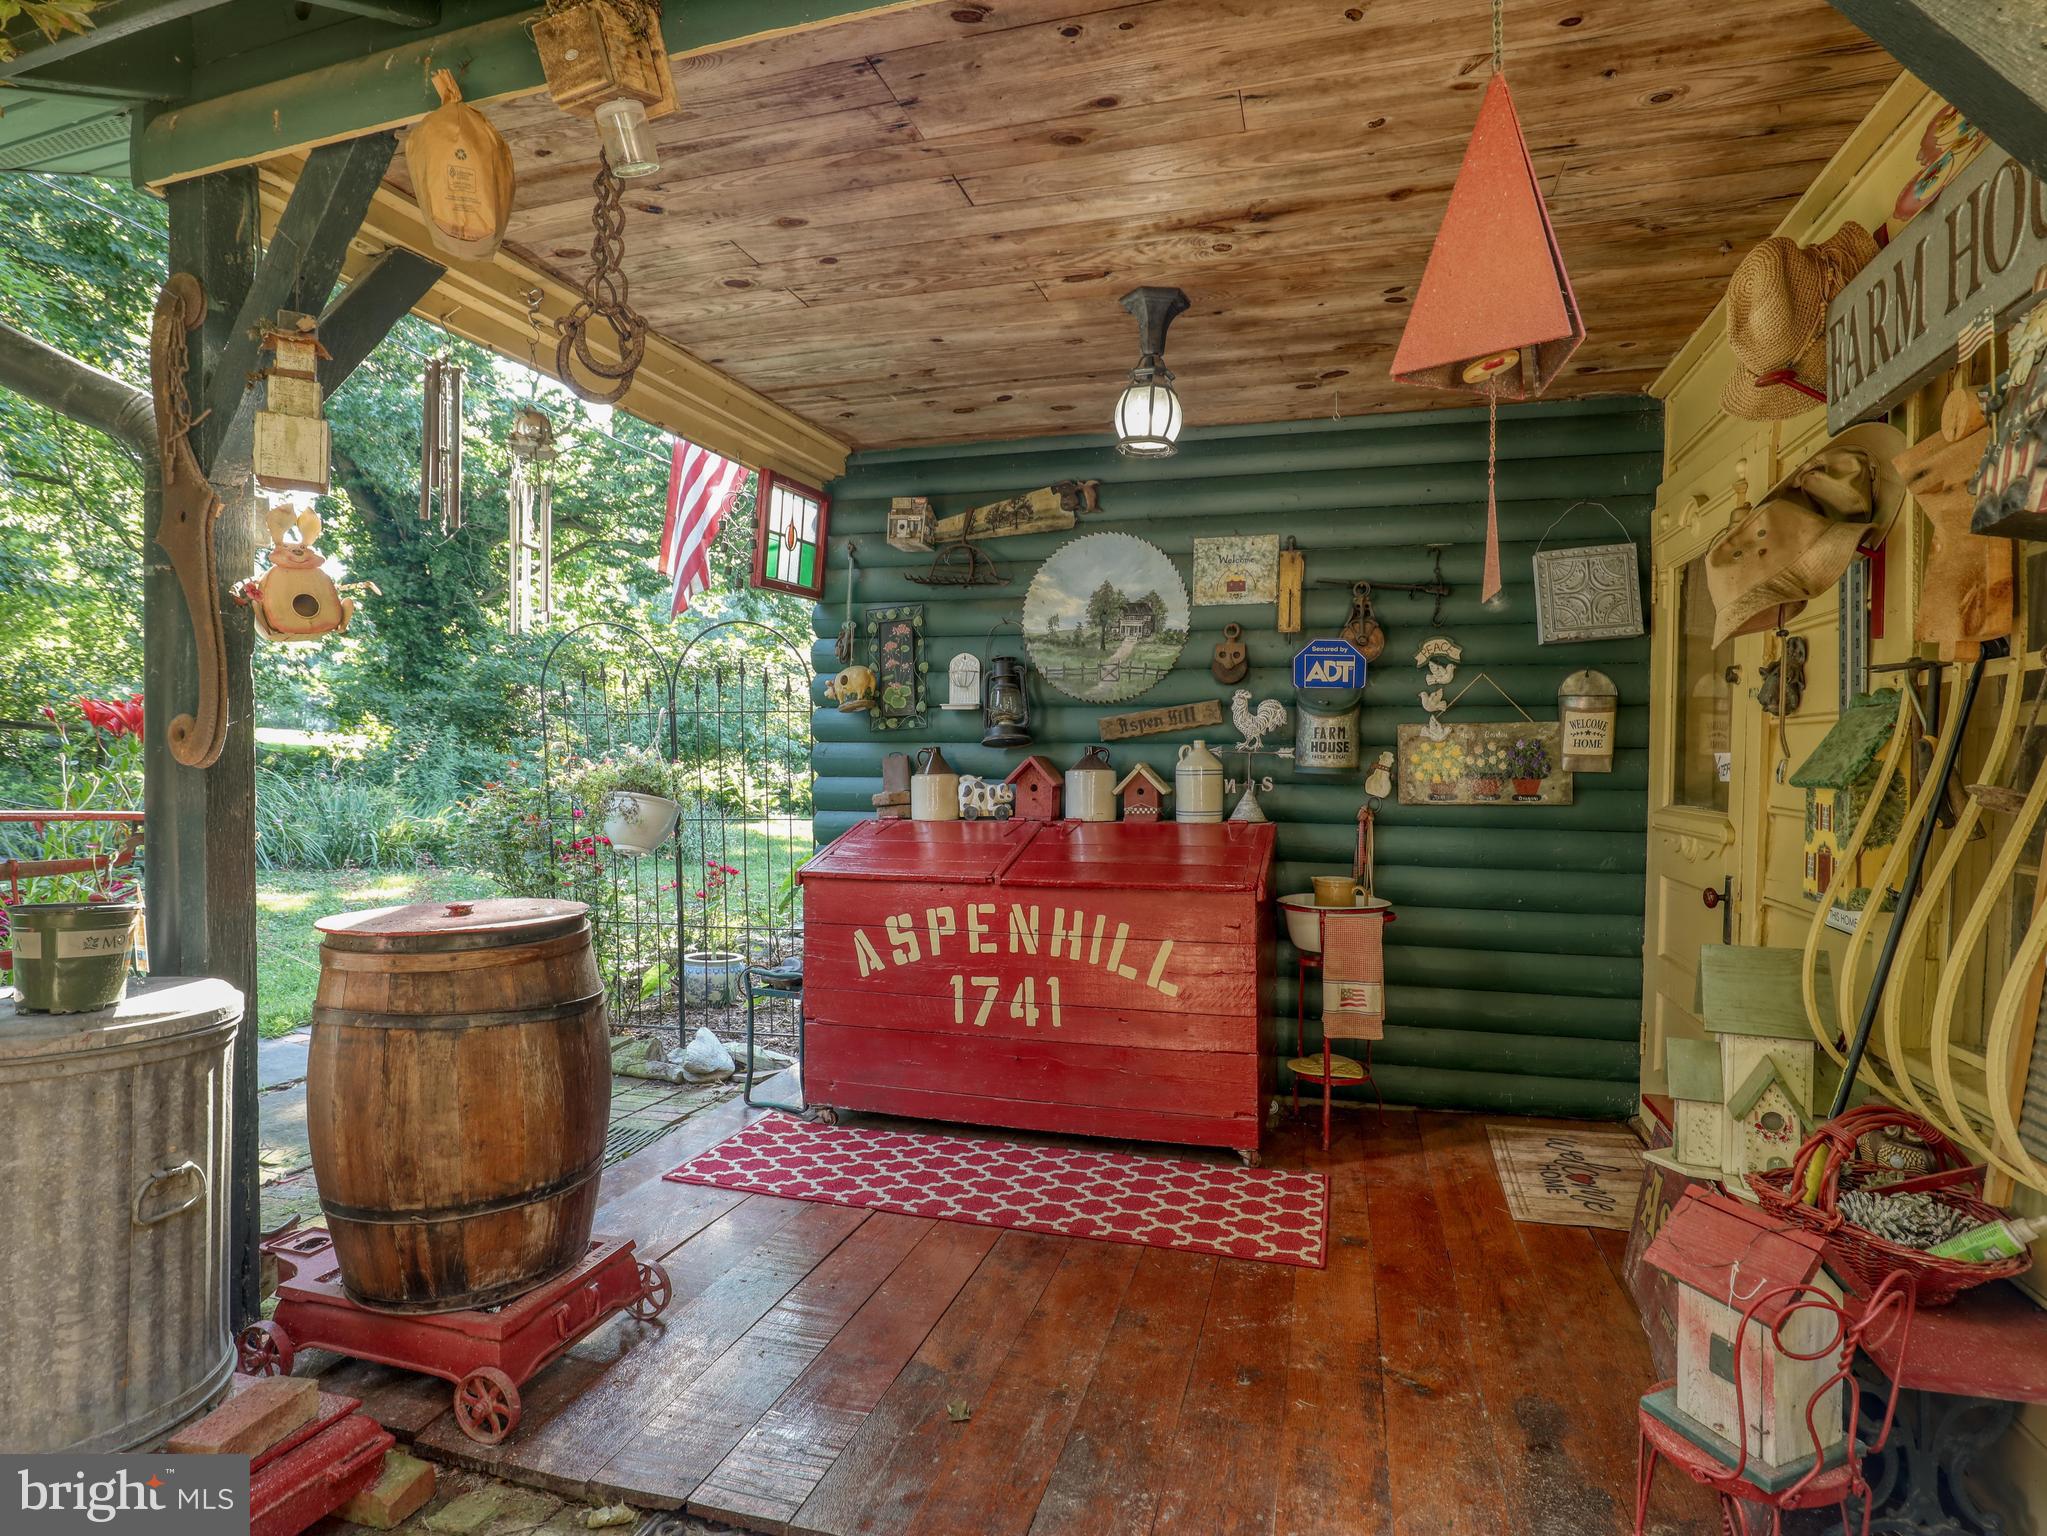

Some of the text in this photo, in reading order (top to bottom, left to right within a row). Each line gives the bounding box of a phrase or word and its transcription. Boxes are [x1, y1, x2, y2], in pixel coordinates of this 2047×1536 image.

[1829, 235, 1930, 407] FARM
[1218, 554, 1255, 564] Welcome
[1311, 645, 1349, 655] Secured by
[1421, 641, 1453, 658] PEACE
[1305, 660, 1354, 683] ADT
[1116, 706, 1196, 734] Aspen Hill
[1568, 718, 1609, 732] WELCOME
[1313, 726, 1346, 740] FARM
[1310, 741, 1350, 753] HOUSE
[1572, 738, 1603, 749] HOME
[854, 903, 1178, 997] ASPENHILL
[949, 975, 1061, 1027] 1741
[1537, 1163, 1570, 1194] HOME
